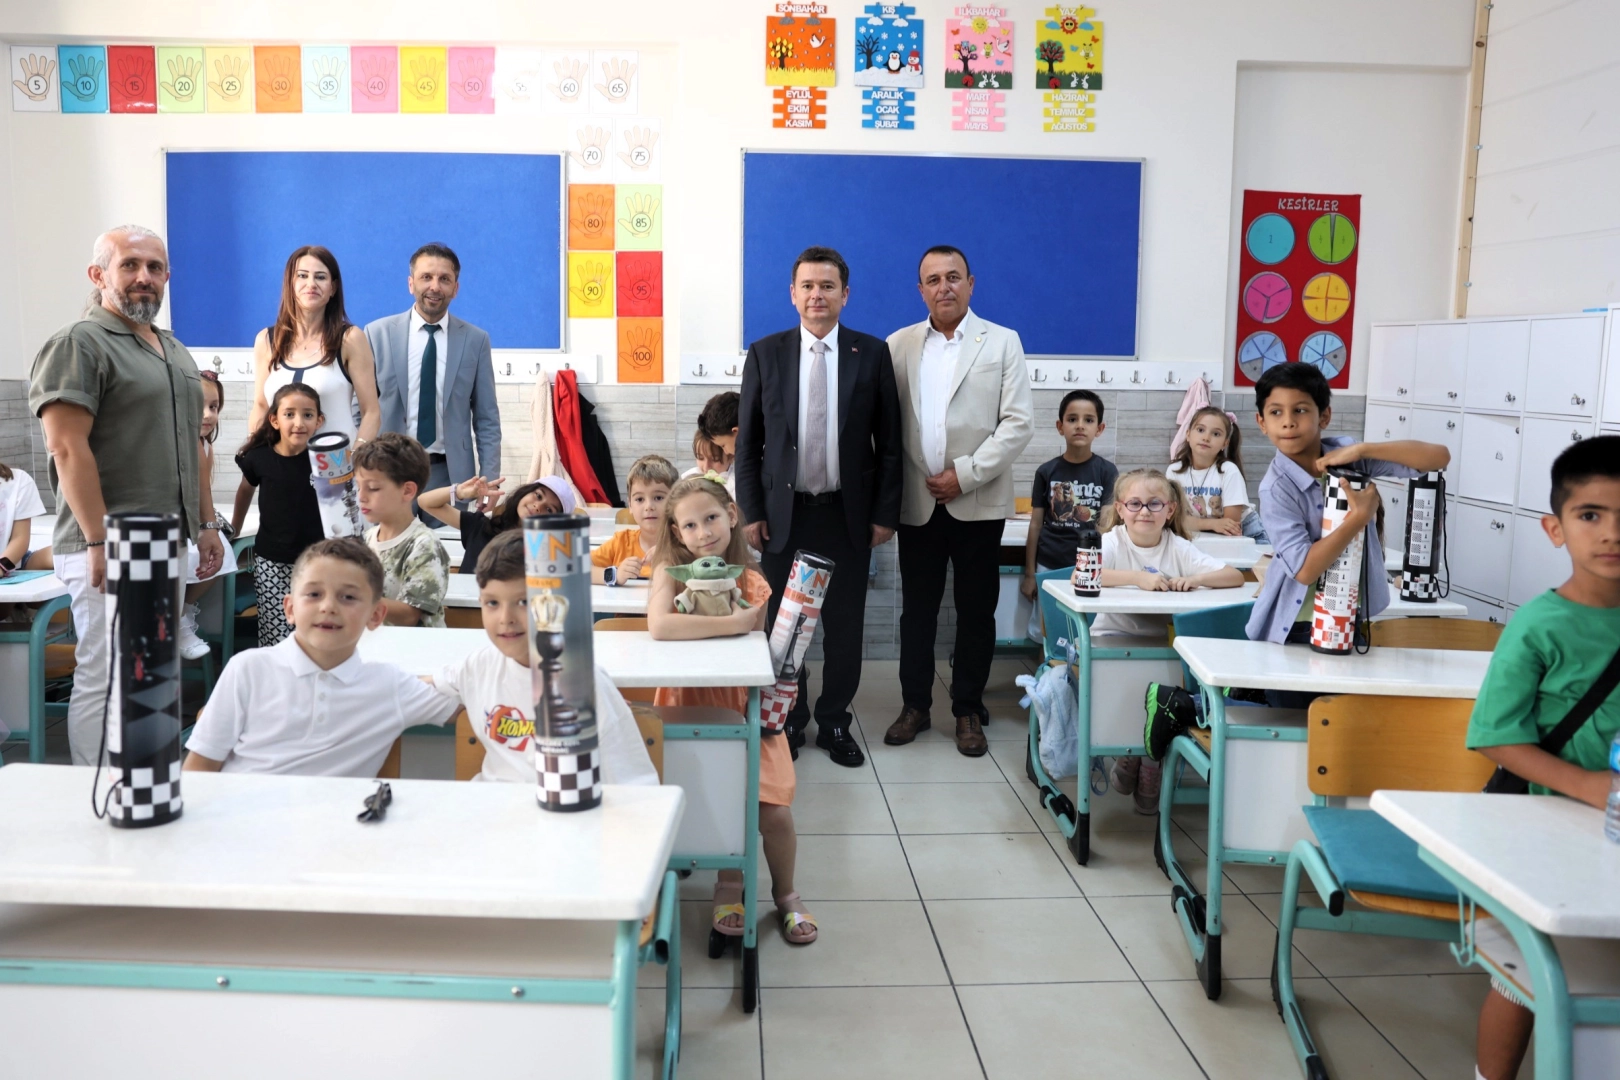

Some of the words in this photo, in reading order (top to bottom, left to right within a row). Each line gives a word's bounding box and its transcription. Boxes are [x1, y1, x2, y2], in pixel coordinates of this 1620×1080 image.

[778, 4, 825, 13] SONBAHAR
[882, 6, 895, 14] KIŞ
[1059, 8, 1077, 16] YAZ
[81, 81, 91, 91] 10
[130, 81, 140, 90] 15
[178, 81, 191, 91] 20
[225, 81, 238, 91] 25
[275, 81, 287, 91] 30
[322, 81, 335, 91] 35
[370, 81, 384, 91] 40
[420, 81, 433, 91] 45
[467, 81, 480, 91] 50
[563, 83, 575, 93] 60
[611, 83, 624, 93] 65
[786, 90, 813, 98] EYLÜL
[871, 91, 903, 100] ARALIK
[966, 93, 990, 101] MART
[787, 104, 810, 113] EKİM
[875, 105, 899, 114] OCAK
[965, 106, 989, 115] NİSAN
[1050, 108, 1085, 116] TEMMUZ
[785, 119, 813, 127] KASIM
[875, 120, 899, 129] ŞUBAT
[965, 121, 988, 130] MAYIS
[585, 151, 598, 160] 70
[634, 151, 646, 161] 75
[1278, 196, 1339, 212] KESİRLER
[587, 218, 600, 229] 80
[635, 218, 647, 228] 85
[587, 286, 599, 296] 90
[636, 285, 647, 295] 95
[634, 351, 651, 361] 100
[316, 449, 352, 470] SV
[526, 530, 573, 562] VN
[790, 562, 829, 590] SVN
